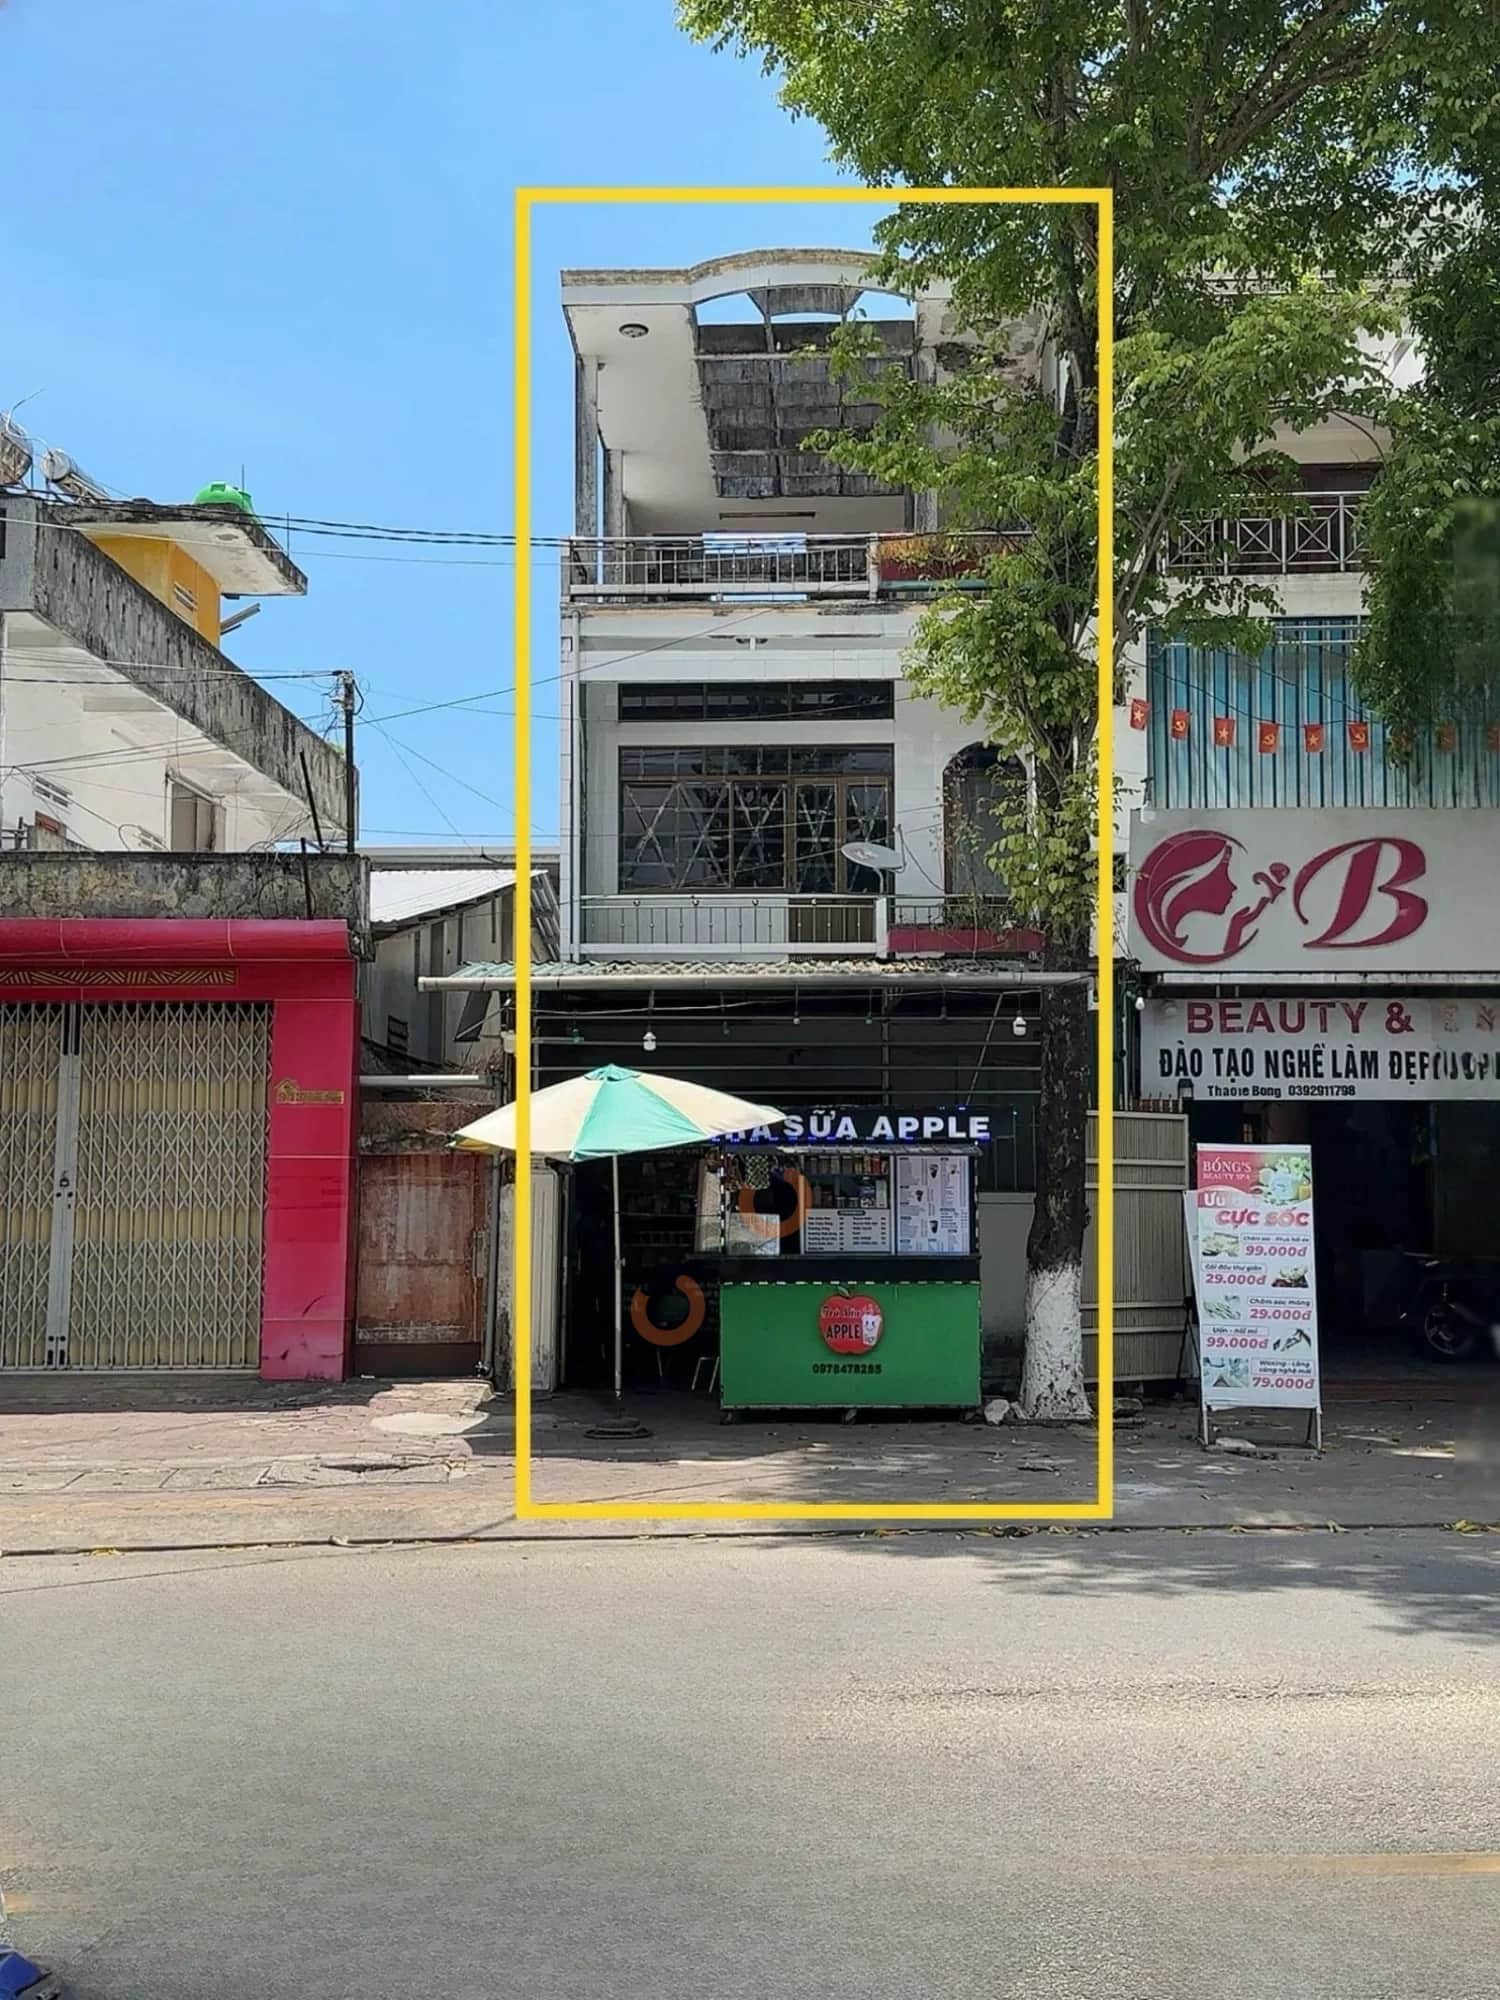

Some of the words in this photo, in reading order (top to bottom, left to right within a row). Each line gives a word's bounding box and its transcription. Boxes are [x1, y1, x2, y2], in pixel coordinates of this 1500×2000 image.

[1187, 1001, 1368, 1034] BEAUTY
[1385, 1002, 1415, 1034] &
[1159, 1040, 1203, 1078] ĐÀO
[1212, 1048, 1254, 1083] TẠO
[1264, 1043, 1326, 1079] NGHỀ
[1331, 1043, 1379, 1079] LÀM
[783, 1109, 858, 1138] SỮA
[872, 1115, 990, 1138] APPLE
[826, 1324, 860, 1339] APPLE
